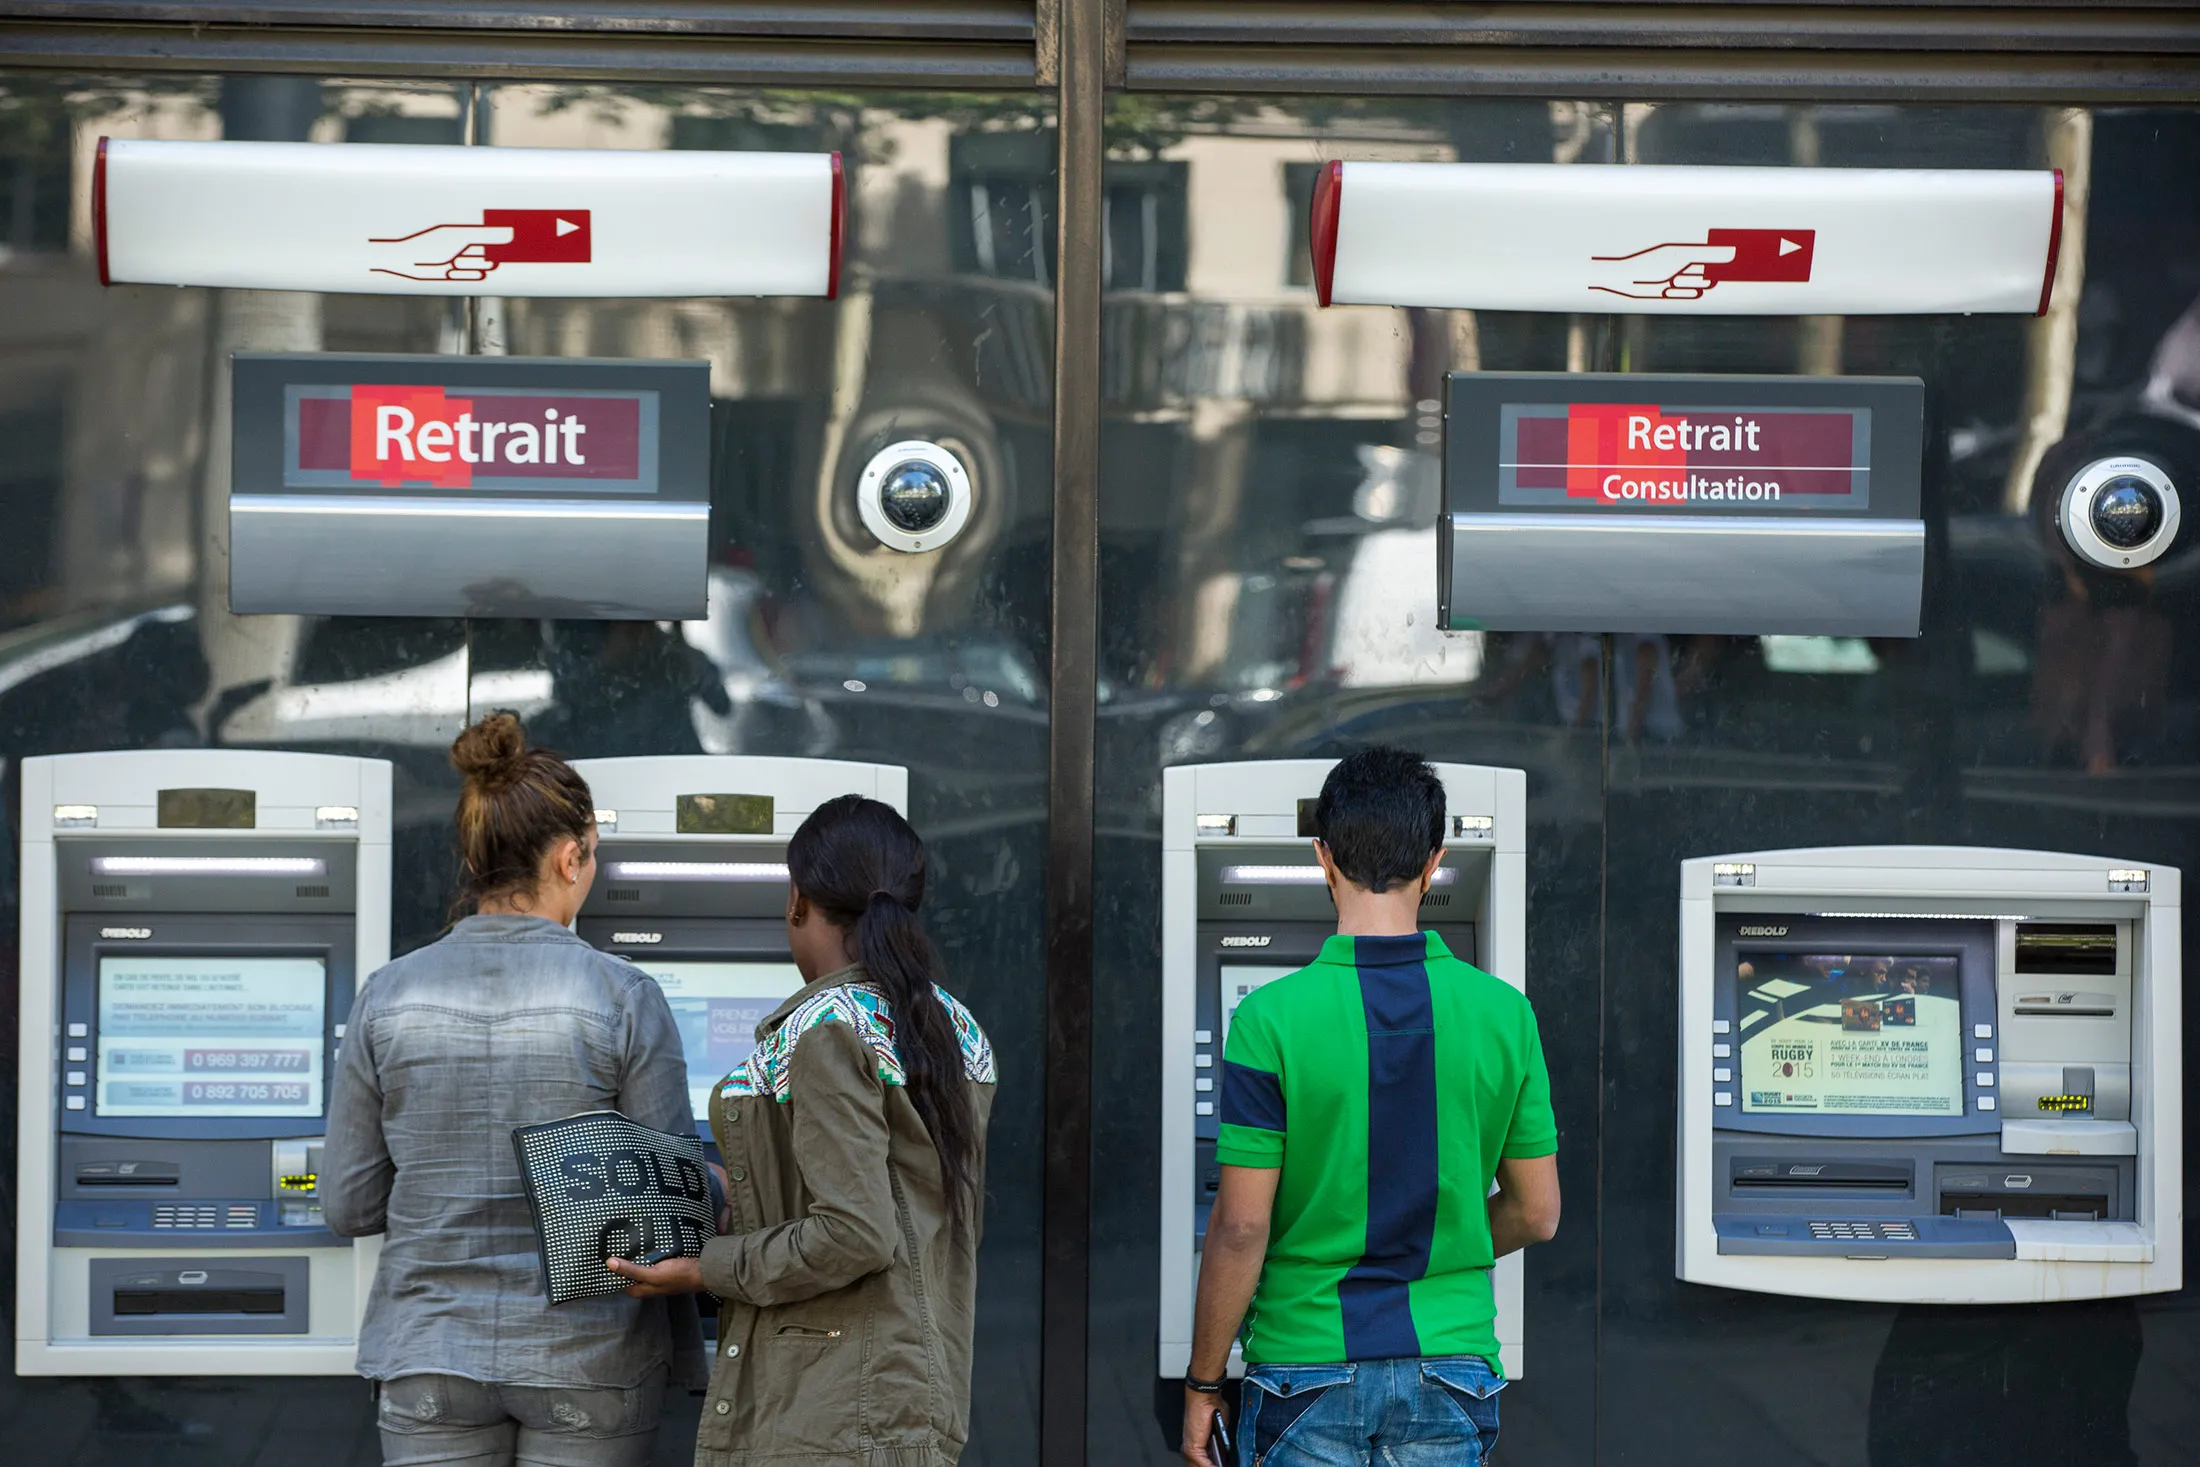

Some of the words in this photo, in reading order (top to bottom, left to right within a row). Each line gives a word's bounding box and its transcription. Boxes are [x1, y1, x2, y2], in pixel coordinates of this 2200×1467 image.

[375, 405, 586, 465] Retrait
[1627, 415, 1761, 452] Retrait
[1602, 473, 1781, 501] Consultation
[611, 932, 663, 943] DIEBOLD
[1738, 926, 1789, 936] DIEBOLD
[1220, 936, 1272, 947] DIEBOLD
[192, 1054, 204, 1067] 0
[206, 1054, 236, 1067] 969
[240, 1054, 270, 1067] 397
[273, 1054, 302, 1067] 777
[1771, 1049, 1813, 1060] RUGBY
[1772, 1062, 1814, 1079] 2015
[192, 1086, 203, 1098] 0
[206, 1086, 235, 1098] 892
[240, 1086, 268, 1098] 705
[273, 1086, 302, 1098] 705
[560, 1149, 706, 1201] SOLD
[599, 1214, 705, 1264] OUT
